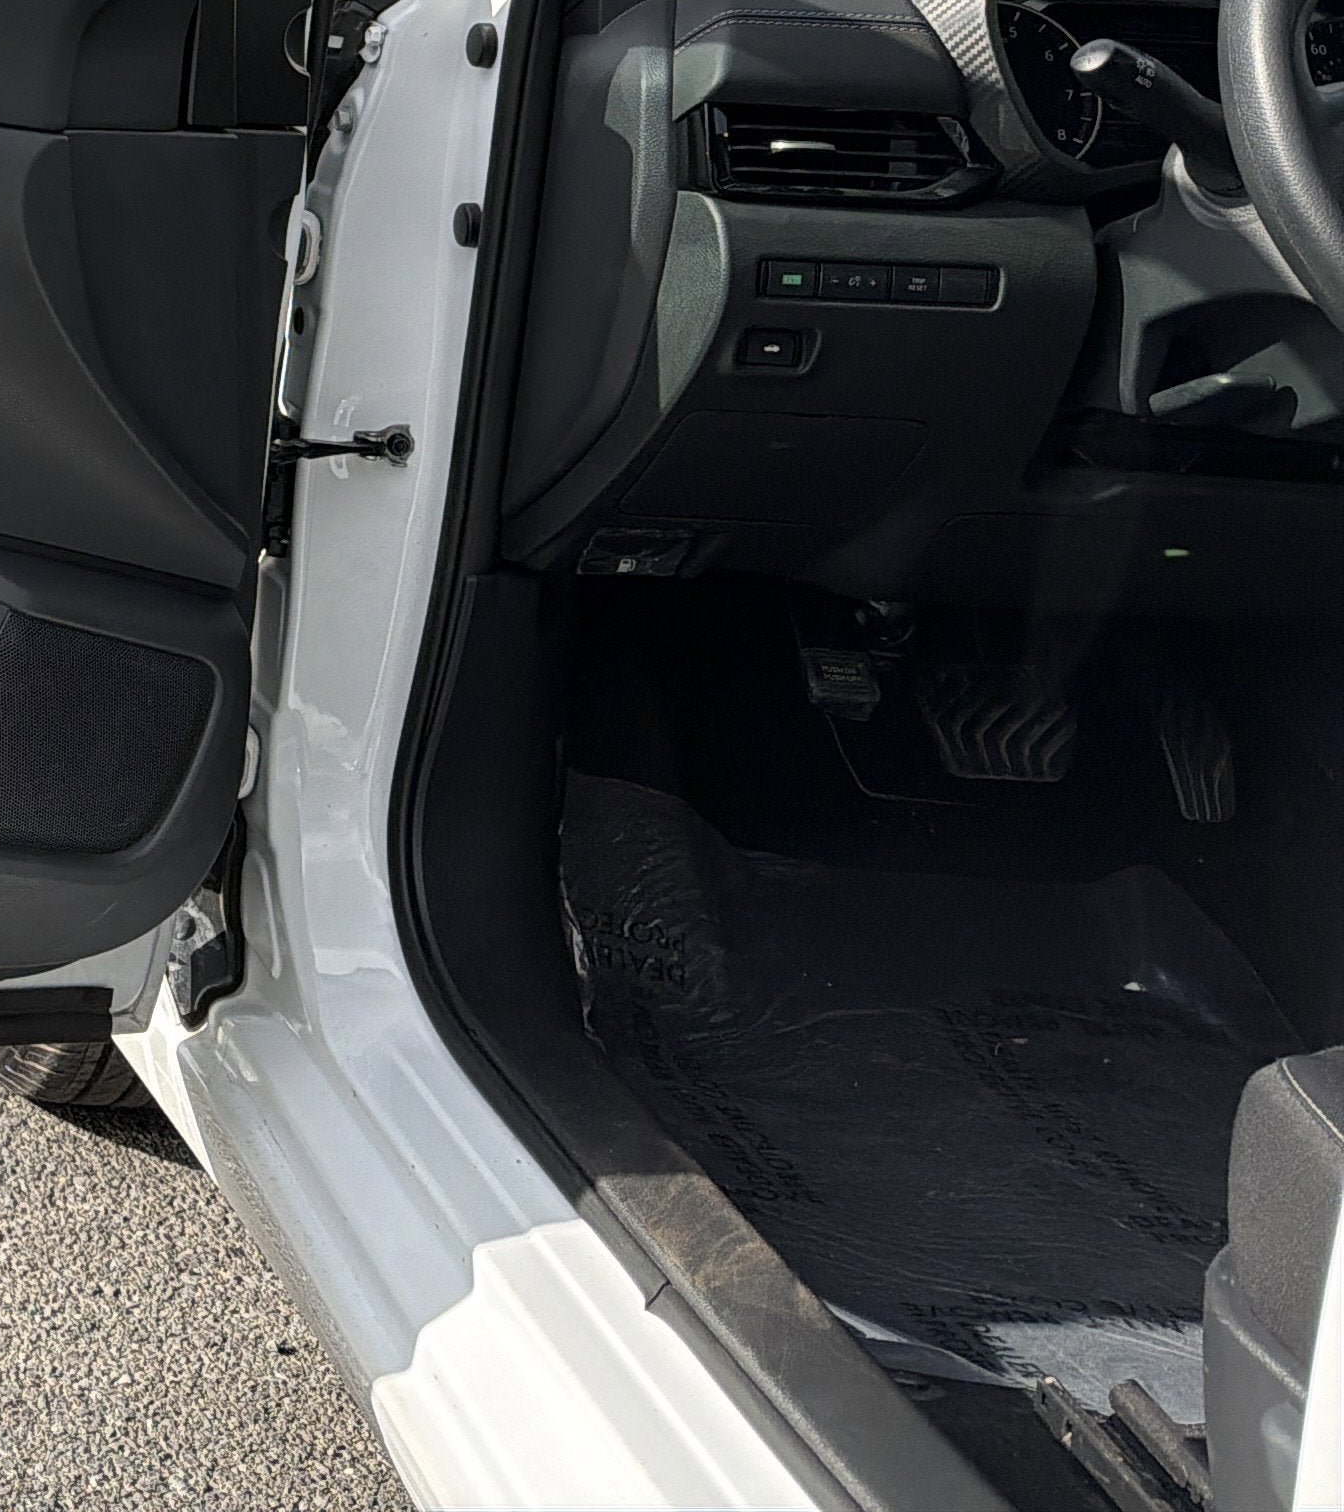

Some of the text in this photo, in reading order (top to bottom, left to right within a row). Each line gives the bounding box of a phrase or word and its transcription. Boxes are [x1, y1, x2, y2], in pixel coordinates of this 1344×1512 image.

[1008, 26, 1018, 39] 5
[1044, 49, 1054, 62] 6
[1310, 43, 1327, 55] 60
[1064, 88, 1074, 101] 7
[1056, 128, 1067, 141] 8
